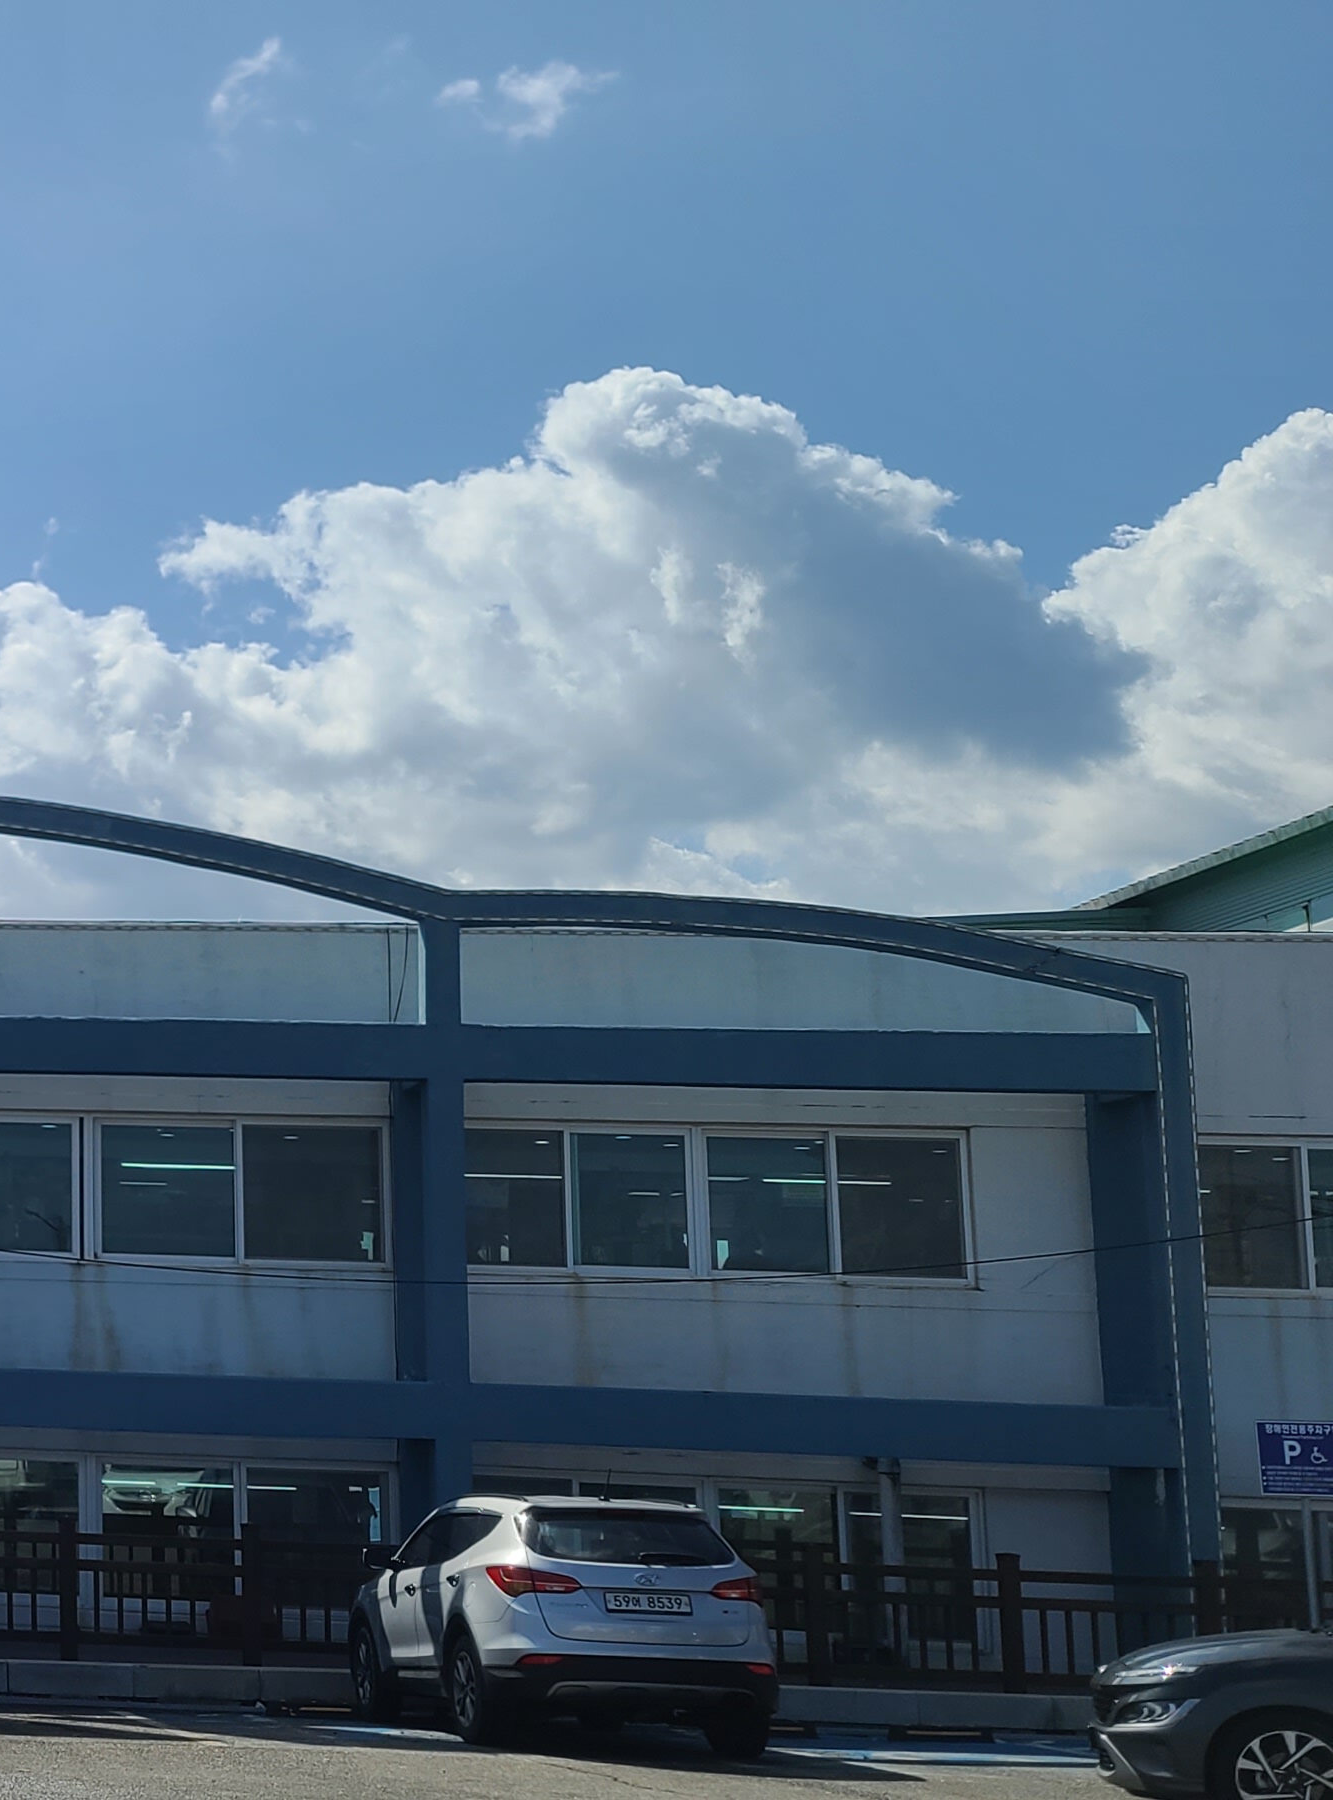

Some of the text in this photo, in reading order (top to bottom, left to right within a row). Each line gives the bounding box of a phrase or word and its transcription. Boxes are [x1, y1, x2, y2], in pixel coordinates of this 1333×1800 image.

[1264, 1423, 1333, 1436] 장애인전용주차구
[1283, 1440, 1302, 1465] P
[647, 1596, 683, 1610] 8539
